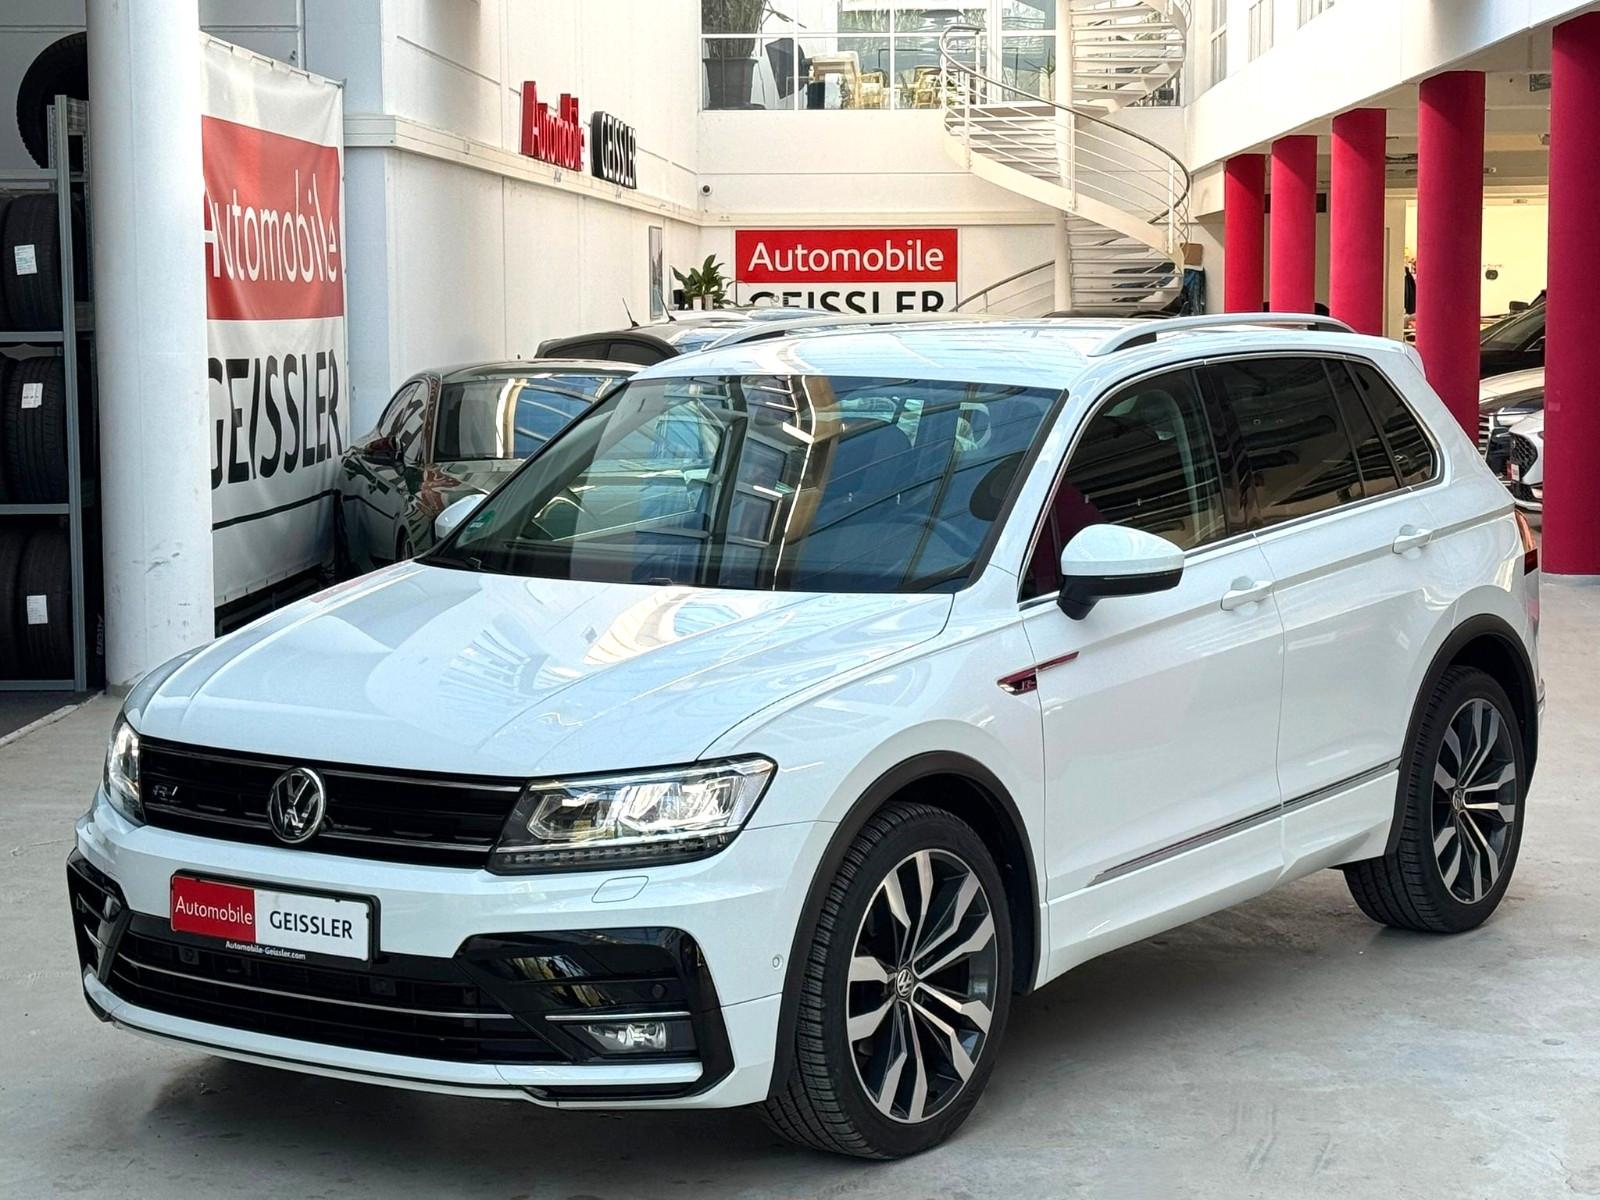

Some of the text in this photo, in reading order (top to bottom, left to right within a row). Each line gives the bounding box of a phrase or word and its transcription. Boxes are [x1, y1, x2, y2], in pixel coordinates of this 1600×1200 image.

[591, 111, 637, 189] GEISSLER
[204, 168, 337, 282] Automobile
[748, 239, 945, 272] Automobile
[208, 349, 343, 490] GEISSLER
[175, 896, 353, 939] Automobile GEISSLER
[225, 941, 306, 960] Automobile-Geissler.com
